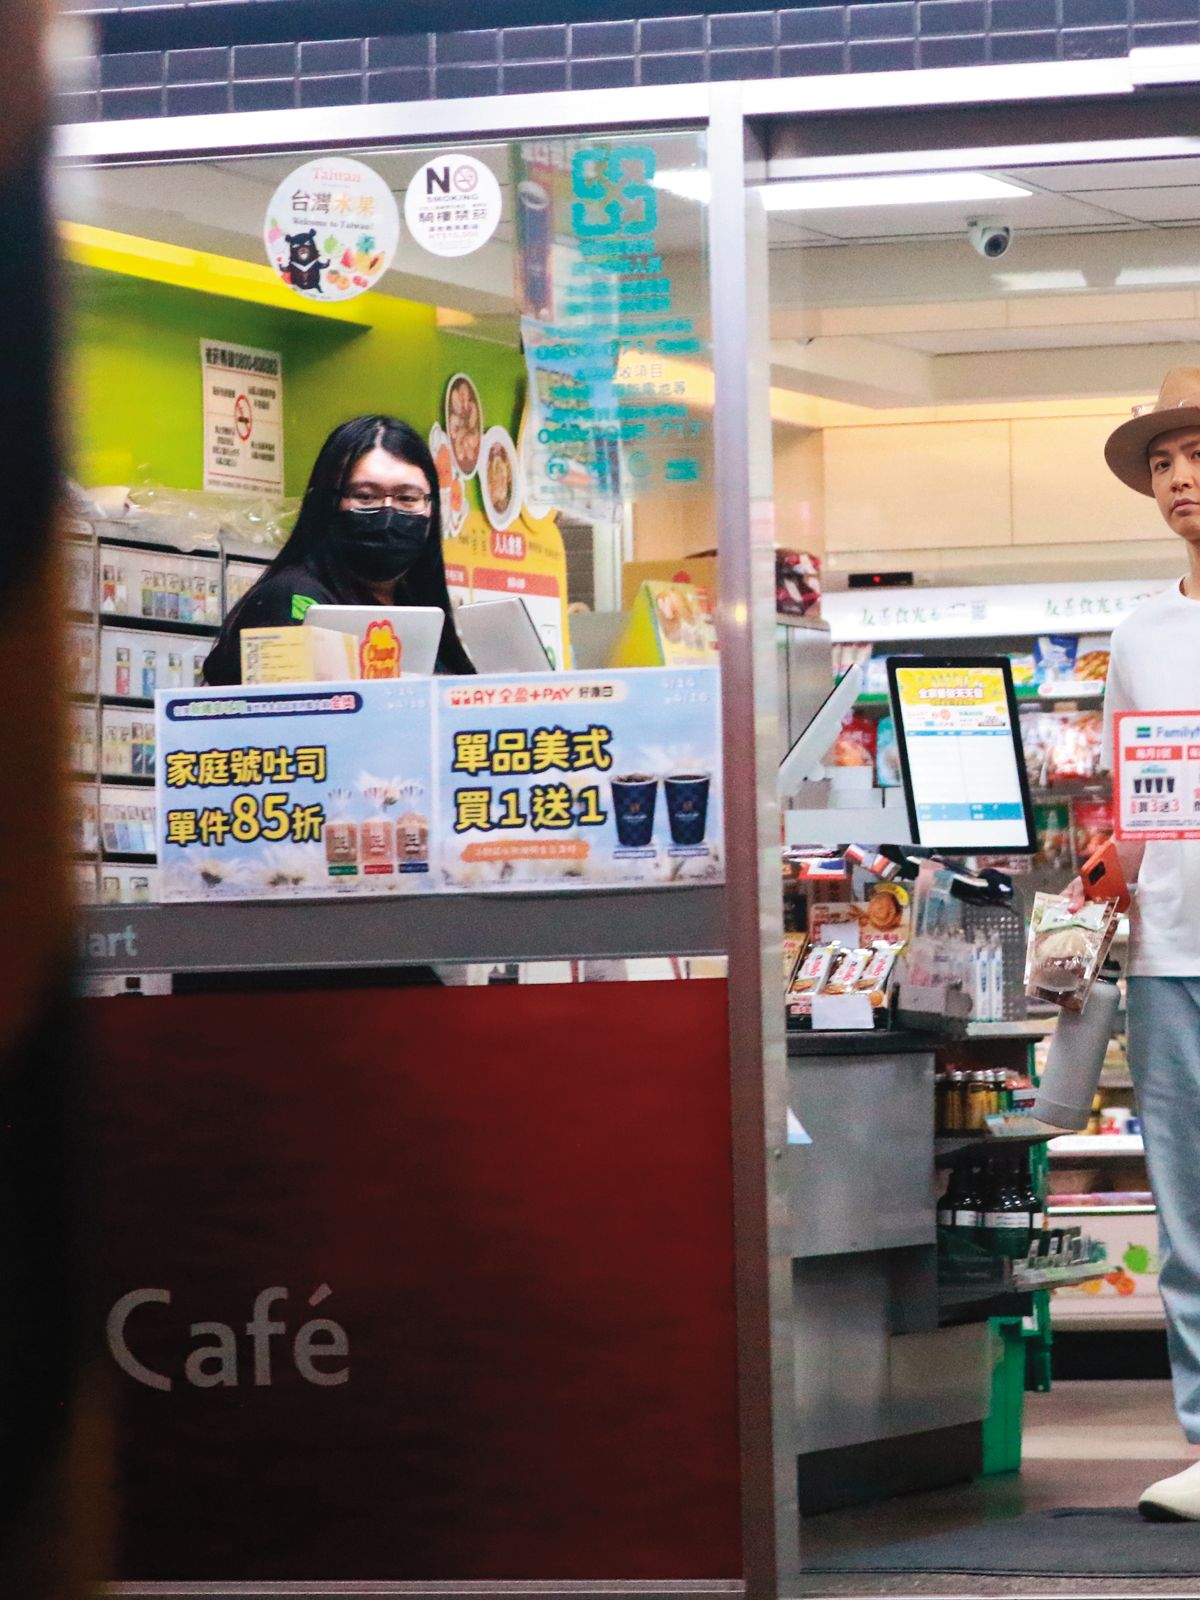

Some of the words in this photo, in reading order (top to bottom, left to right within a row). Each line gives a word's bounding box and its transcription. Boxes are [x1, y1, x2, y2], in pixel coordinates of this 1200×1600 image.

[312, 166, 361, 183] Taiwan
[291, 189, 375, 216] 台灣水果
[166, 745, 327, 787] 家庭號吐司
[452, 723, 613, 776] 單品美式
[166, 792, 326, 847] 單件85折
[454, 782, 609, 834] 買1送1
[106, 1283, 350, 1392] Café
